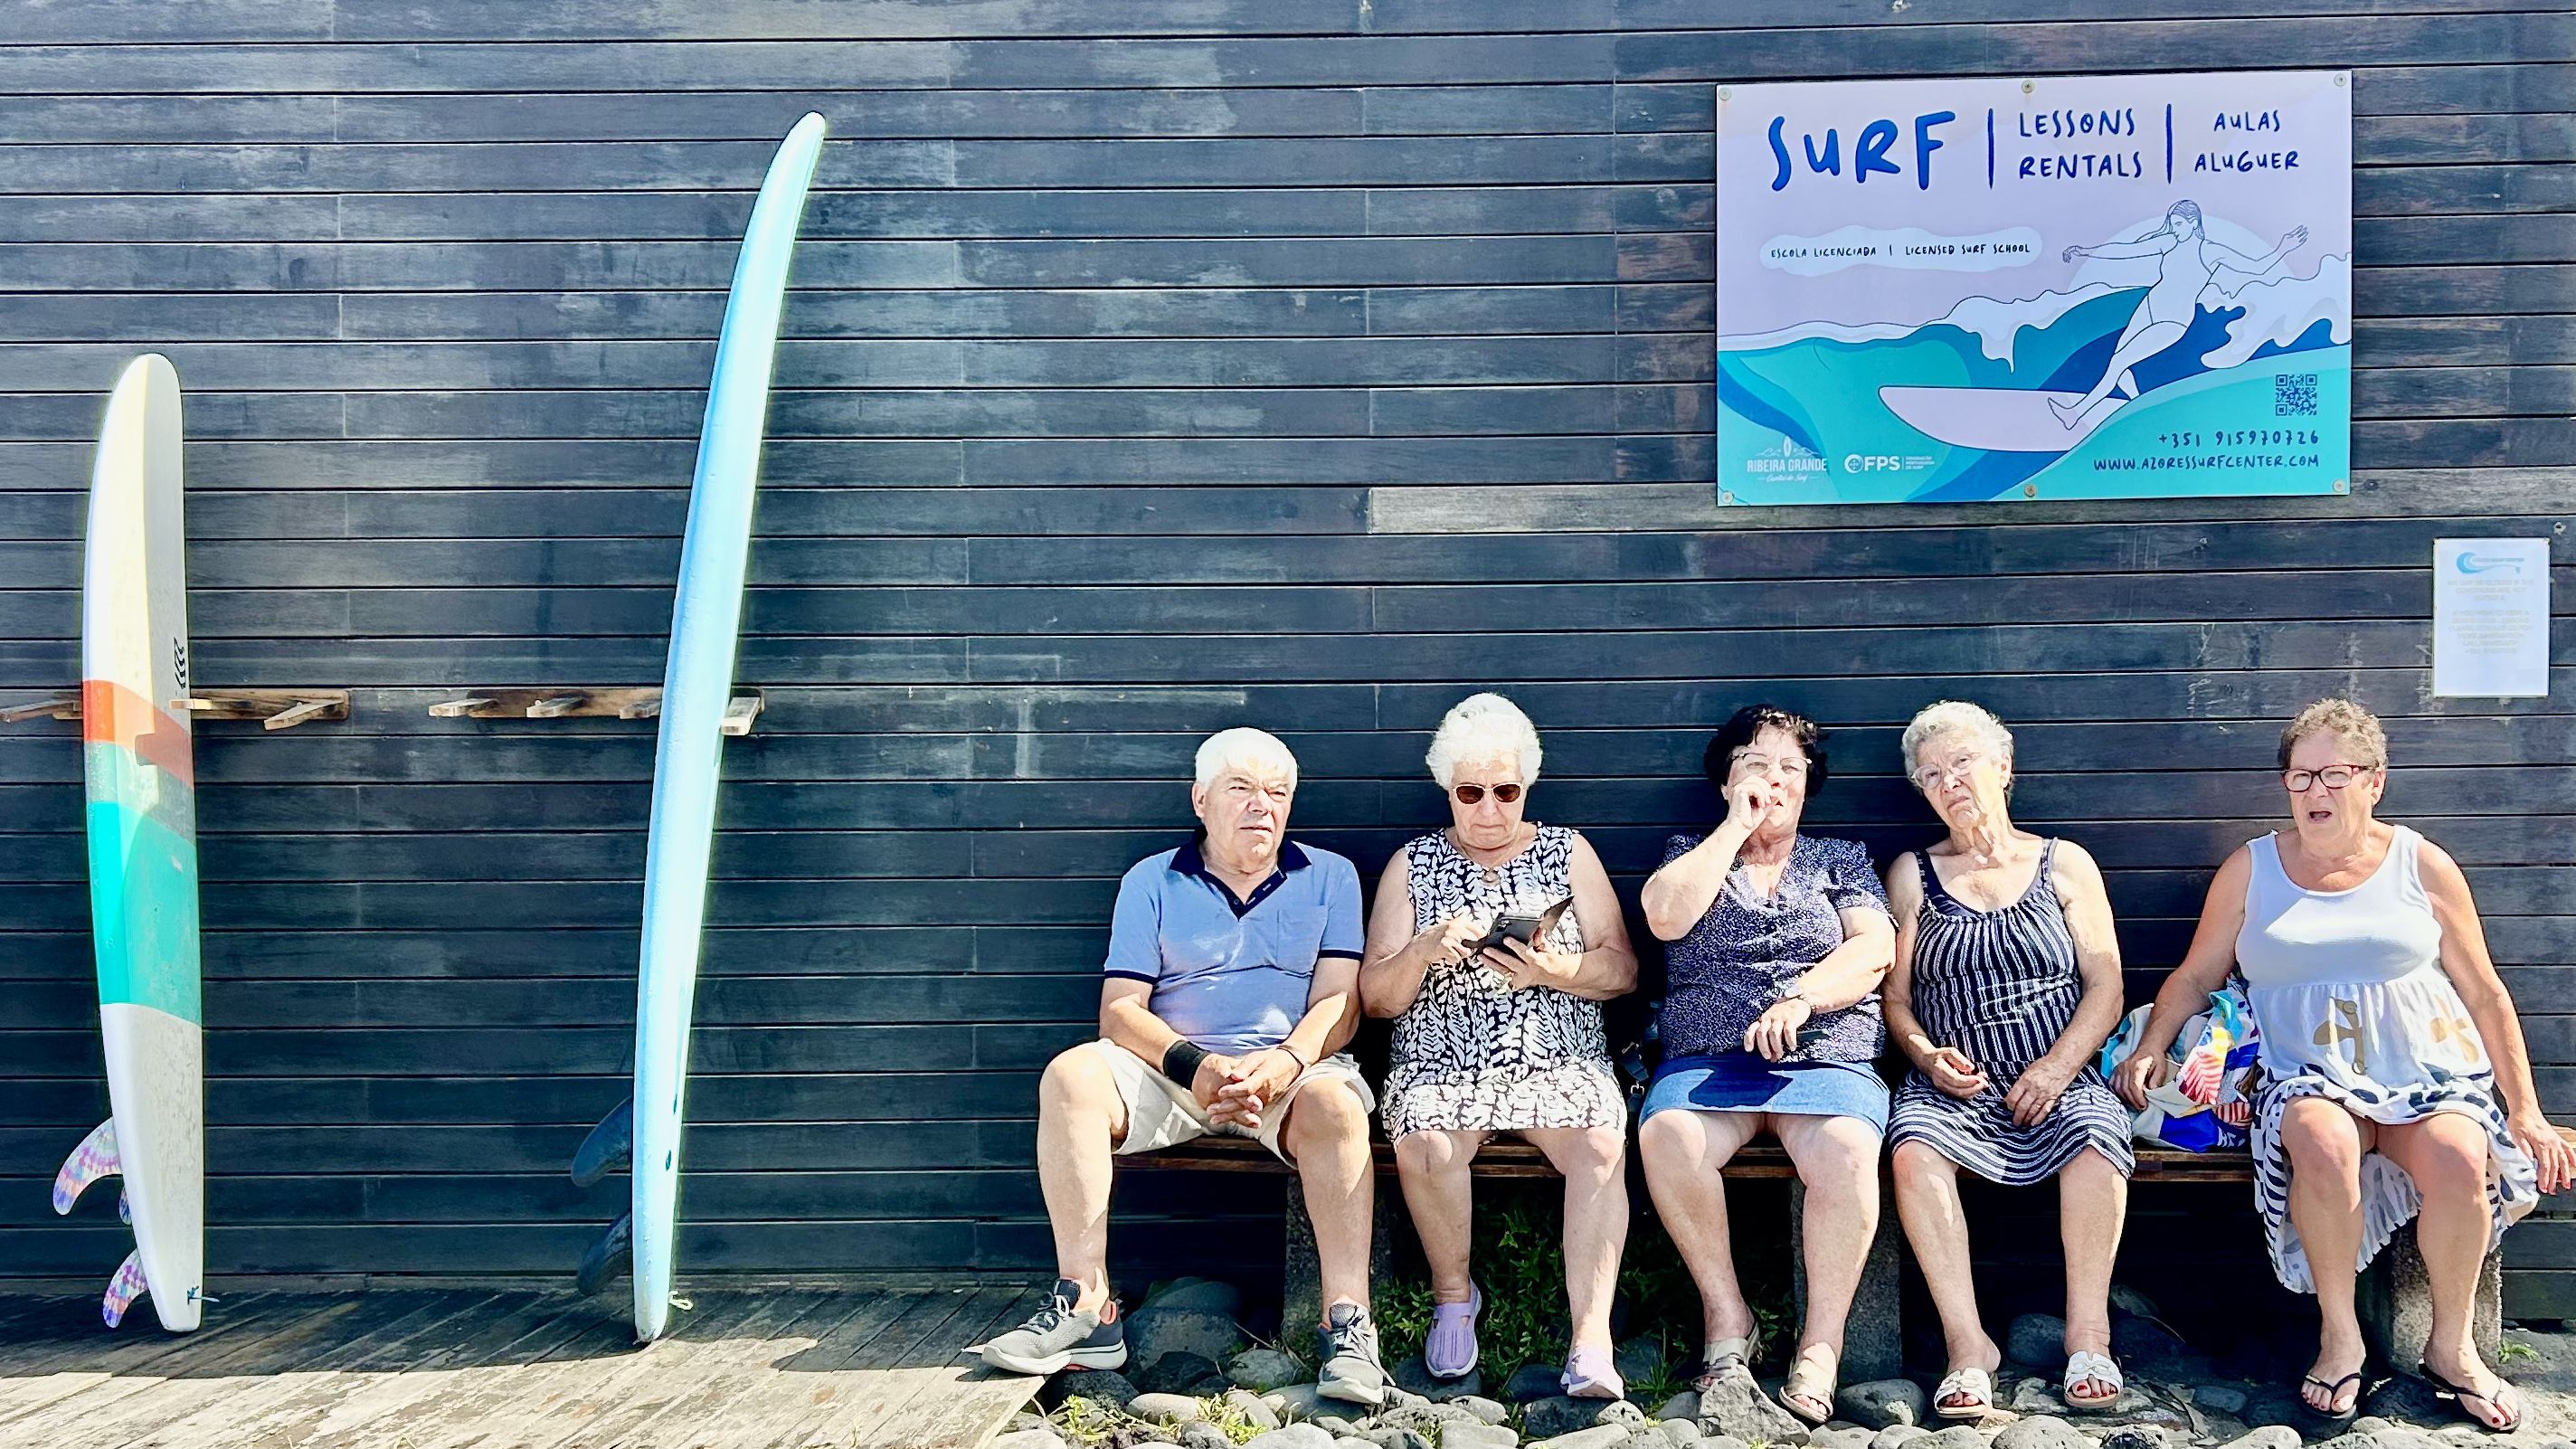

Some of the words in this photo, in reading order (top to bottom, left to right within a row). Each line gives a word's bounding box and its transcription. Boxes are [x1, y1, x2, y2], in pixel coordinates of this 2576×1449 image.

[2019, 107, 2136, 138] LESSONS
[2213, 109, 2281, 133] AULAS
[1767, 109, 1956, 193] SURF
[2193, 149, 2300, 174] ALUGUER
[2018, 150, 2143, 180] RENTALS
[1770, 247, 1807, 260] ESCOLA
[1814, 246, 1877, 258] LICENCIADA
[1905, 243, 1956, 256] LICENSED
[1961, 243, 1987, 255] SURF
[1993, 242, 2031, 254] SCHOOL
[2158, 432, 2201, 449] +351
[2215, 430, 2319, 447] 915970726
[1747, 459, 1785, 473] RIBEIRA
[1787, 457, 1827, 471] GRANDE
[1864, 455, 1900, 471] FPS
[2093, 454, 2319, 471] WWW.AZORESSURFCENTER.COM
